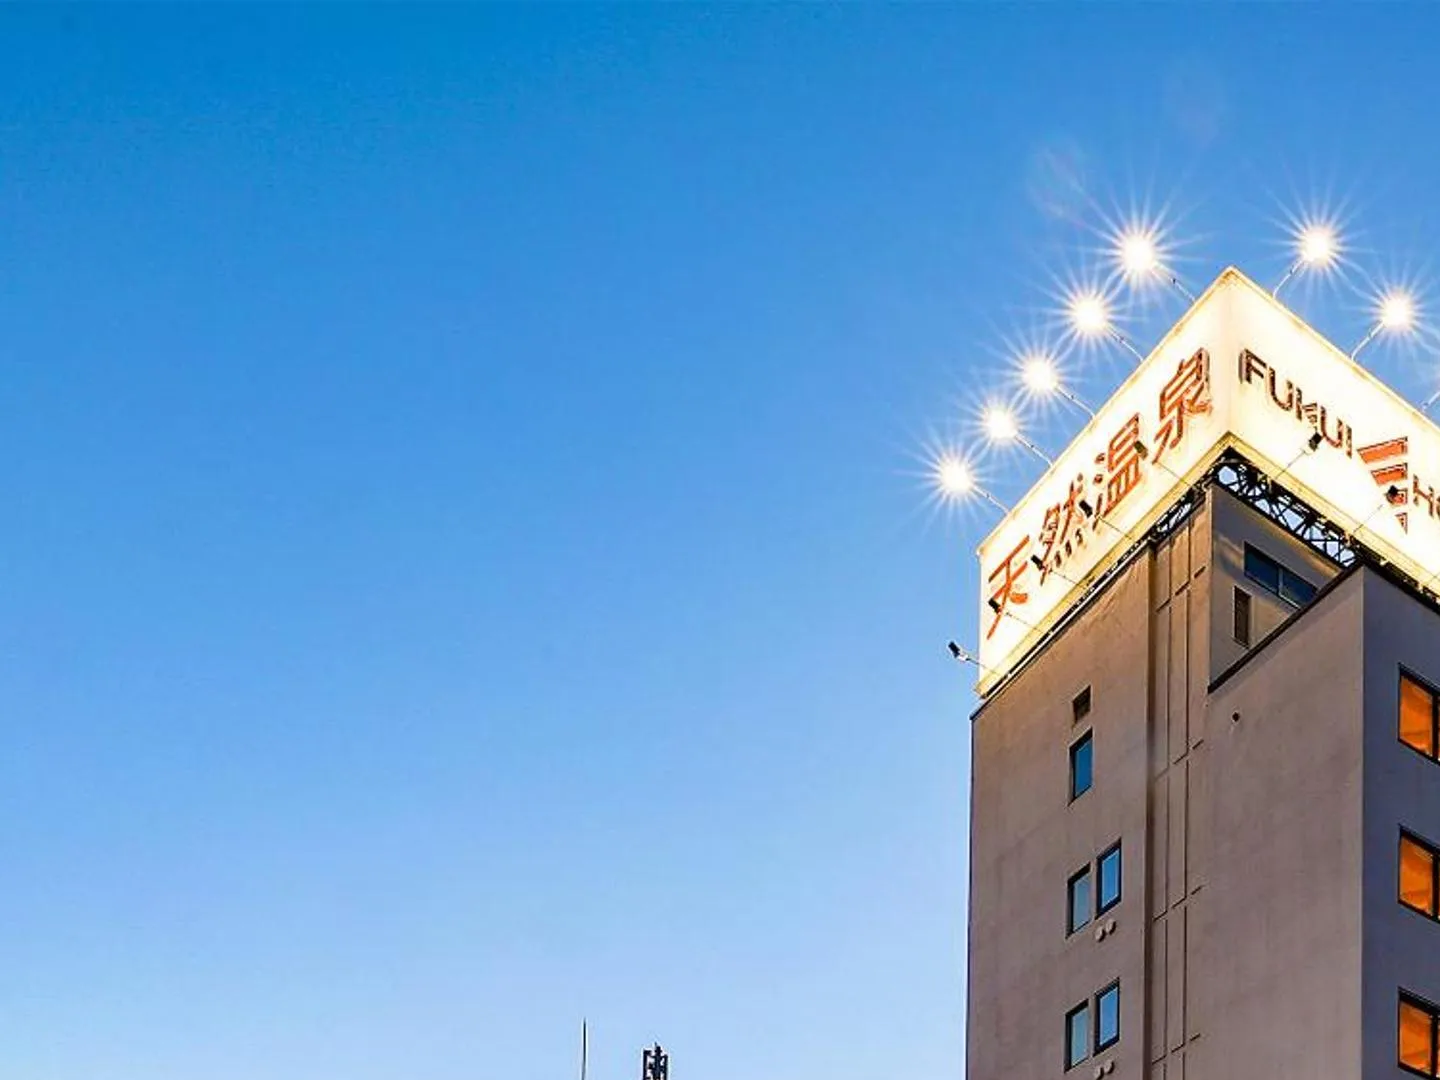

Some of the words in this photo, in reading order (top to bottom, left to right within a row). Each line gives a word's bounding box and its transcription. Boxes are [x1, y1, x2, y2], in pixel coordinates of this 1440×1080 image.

[986, 347, 1212, 640] 天然温泉
[1239, 348, 1353, 459] FUKUI
